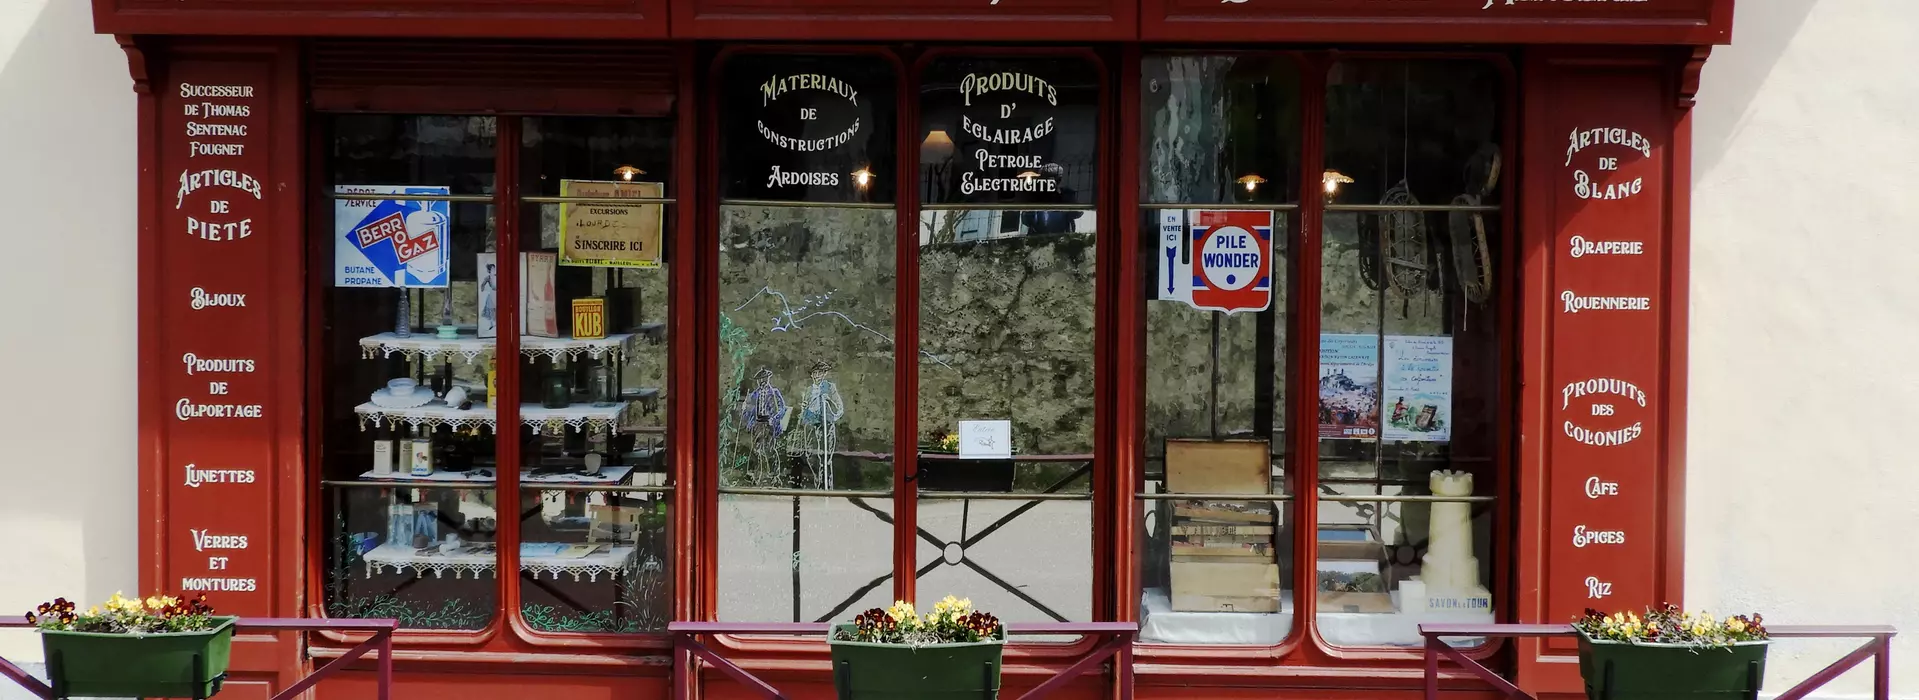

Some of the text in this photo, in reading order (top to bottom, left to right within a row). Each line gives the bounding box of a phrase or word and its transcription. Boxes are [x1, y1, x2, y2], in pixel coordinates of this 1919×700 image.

[180, 82, 254, 99] SUCCESSEUR
[760, 73, 858, 107] MATERIAUX
[959, 72, 1058, 108] PRODUITS
[184, 102, 251, 119] DE THOMAS
[800, 108, 817, 120] DE
[1000, 101, 1017, 120] D'
[186, 121, 248, 138] SENTENAC
[757, 116, 861, 153] CONSTRUCTIONS
[963, 113, 1055, 146] ECLAIRAGE
[189, 141, 245, 158] FOUGNET
[1565, 126, 1651, 168] ARTICLES
[975, 148, 1042, 172] PETROLE
[1598, 157, 1618, 171] DE
[766, 165, 840, 189] ARDOISES
[960, 171, 1057, 196] ELECTRICITE
[1573, 169, 1643, 201] BLANC
[175, 168, 263, 210] ARTICLES
[210, 200, 230, 214] DE
[187, 217, 252, 242] PIETE
[1167, 215, 1176, 223] EN
[359, 217, 403, 245] BERR
[1216, 235, 1247, 249] PILE
[398, 234, 437, 260] GAZ
[629, 241, 643, 251] ICI
[1570, 235, 1644, 258] DRAPERIE
[344, 266, 375, 274] BUTANE
[1204, 253, 1259, 268] WONDER
[344, 277, 382, 285] PROPANE
[190, 287, 246, 310] BIJOUX
[1561, 290, 1651, 314] ROUENNERIE
[575, 312, 602, 336] KUB
[182, 352, 255, 375] PRODUITS
[209, 381, 229, 396] DE
[1562, 377, 1647, 411] PRODUITS
[175, 397, 263, 421] COLPORTAGE
[1591, 403, 1615, 417] DES
[1563, 419, 1643, 448] COLONIES
[184, 463, 255, 488] LUNETTES
[1584, 476, 1619, 499] CAFE
[190, 528, 249, 552] VERRES
[1572, 524, 1626, 549] EPICES
[208, 556, 229, 570] ET
[182, 577, 257, 592] MONTURES
[1584, 576, 1613, 600] RIZ
[1429, 597, 1458, 608] SAVON
[1466, 597, 1489, 609] TOUR
